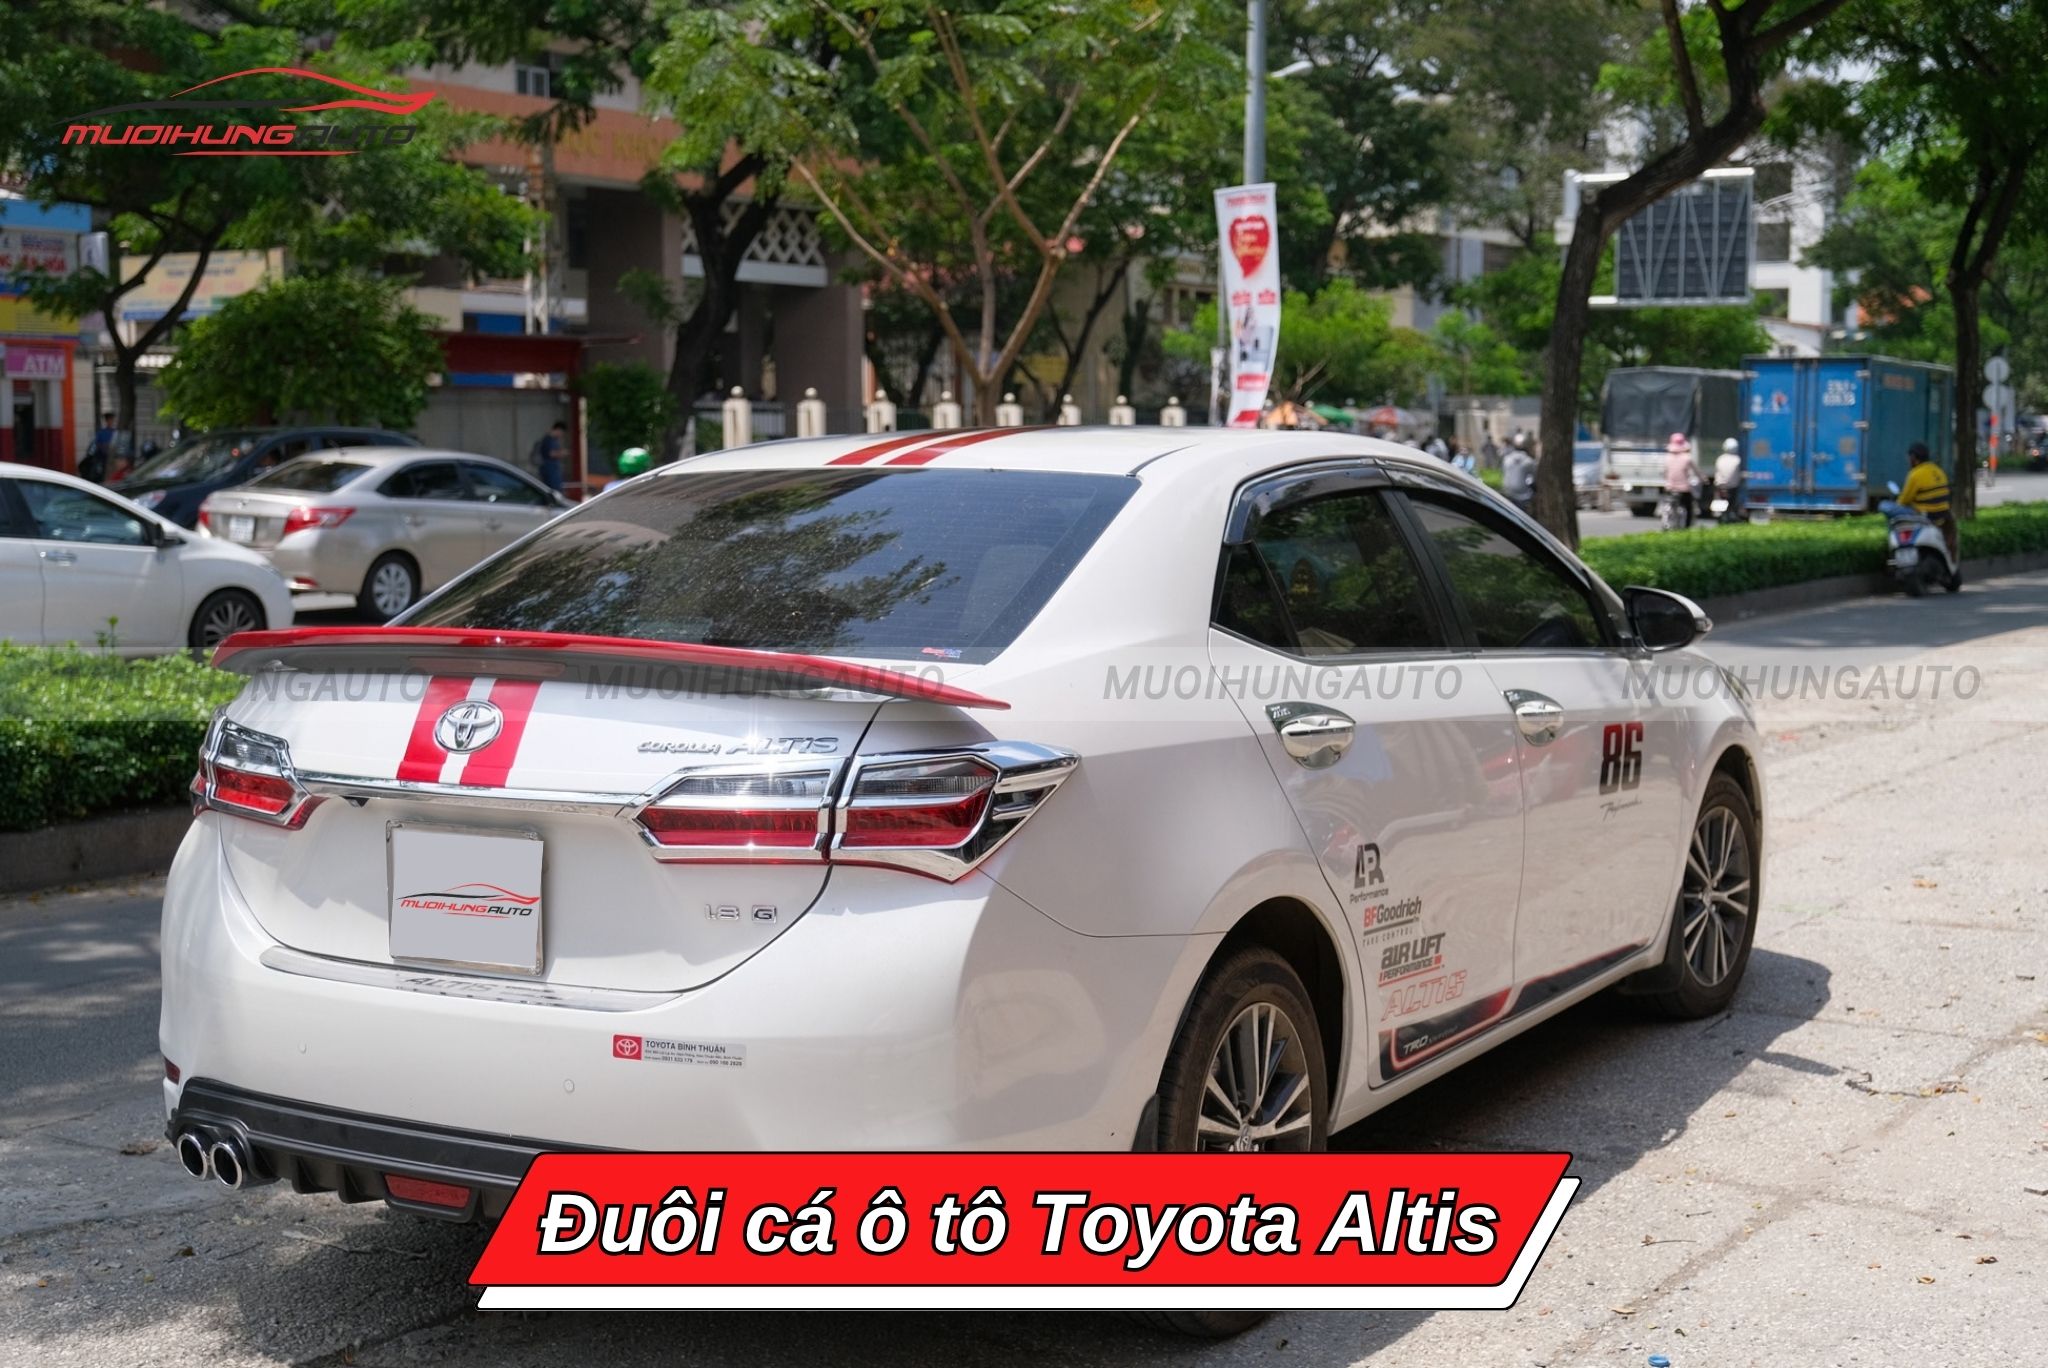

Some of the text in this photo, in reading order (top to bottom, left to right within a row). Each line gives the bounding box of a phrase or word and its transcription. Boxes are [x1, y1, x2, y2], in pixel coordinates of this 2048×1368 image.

[24, 354, 65, 374] ATM
[637, 736, 840, 755] COROLLA ALTIS
[1599, 721, 1643, 796] 86
[1349, 887, 1389, 904] Performance
[1363, 896, 1422, 928] BFGoodrich
[1411, 932, 1447, 961] LIFT
[645, 1040, 676, 1050] TOYOTA
